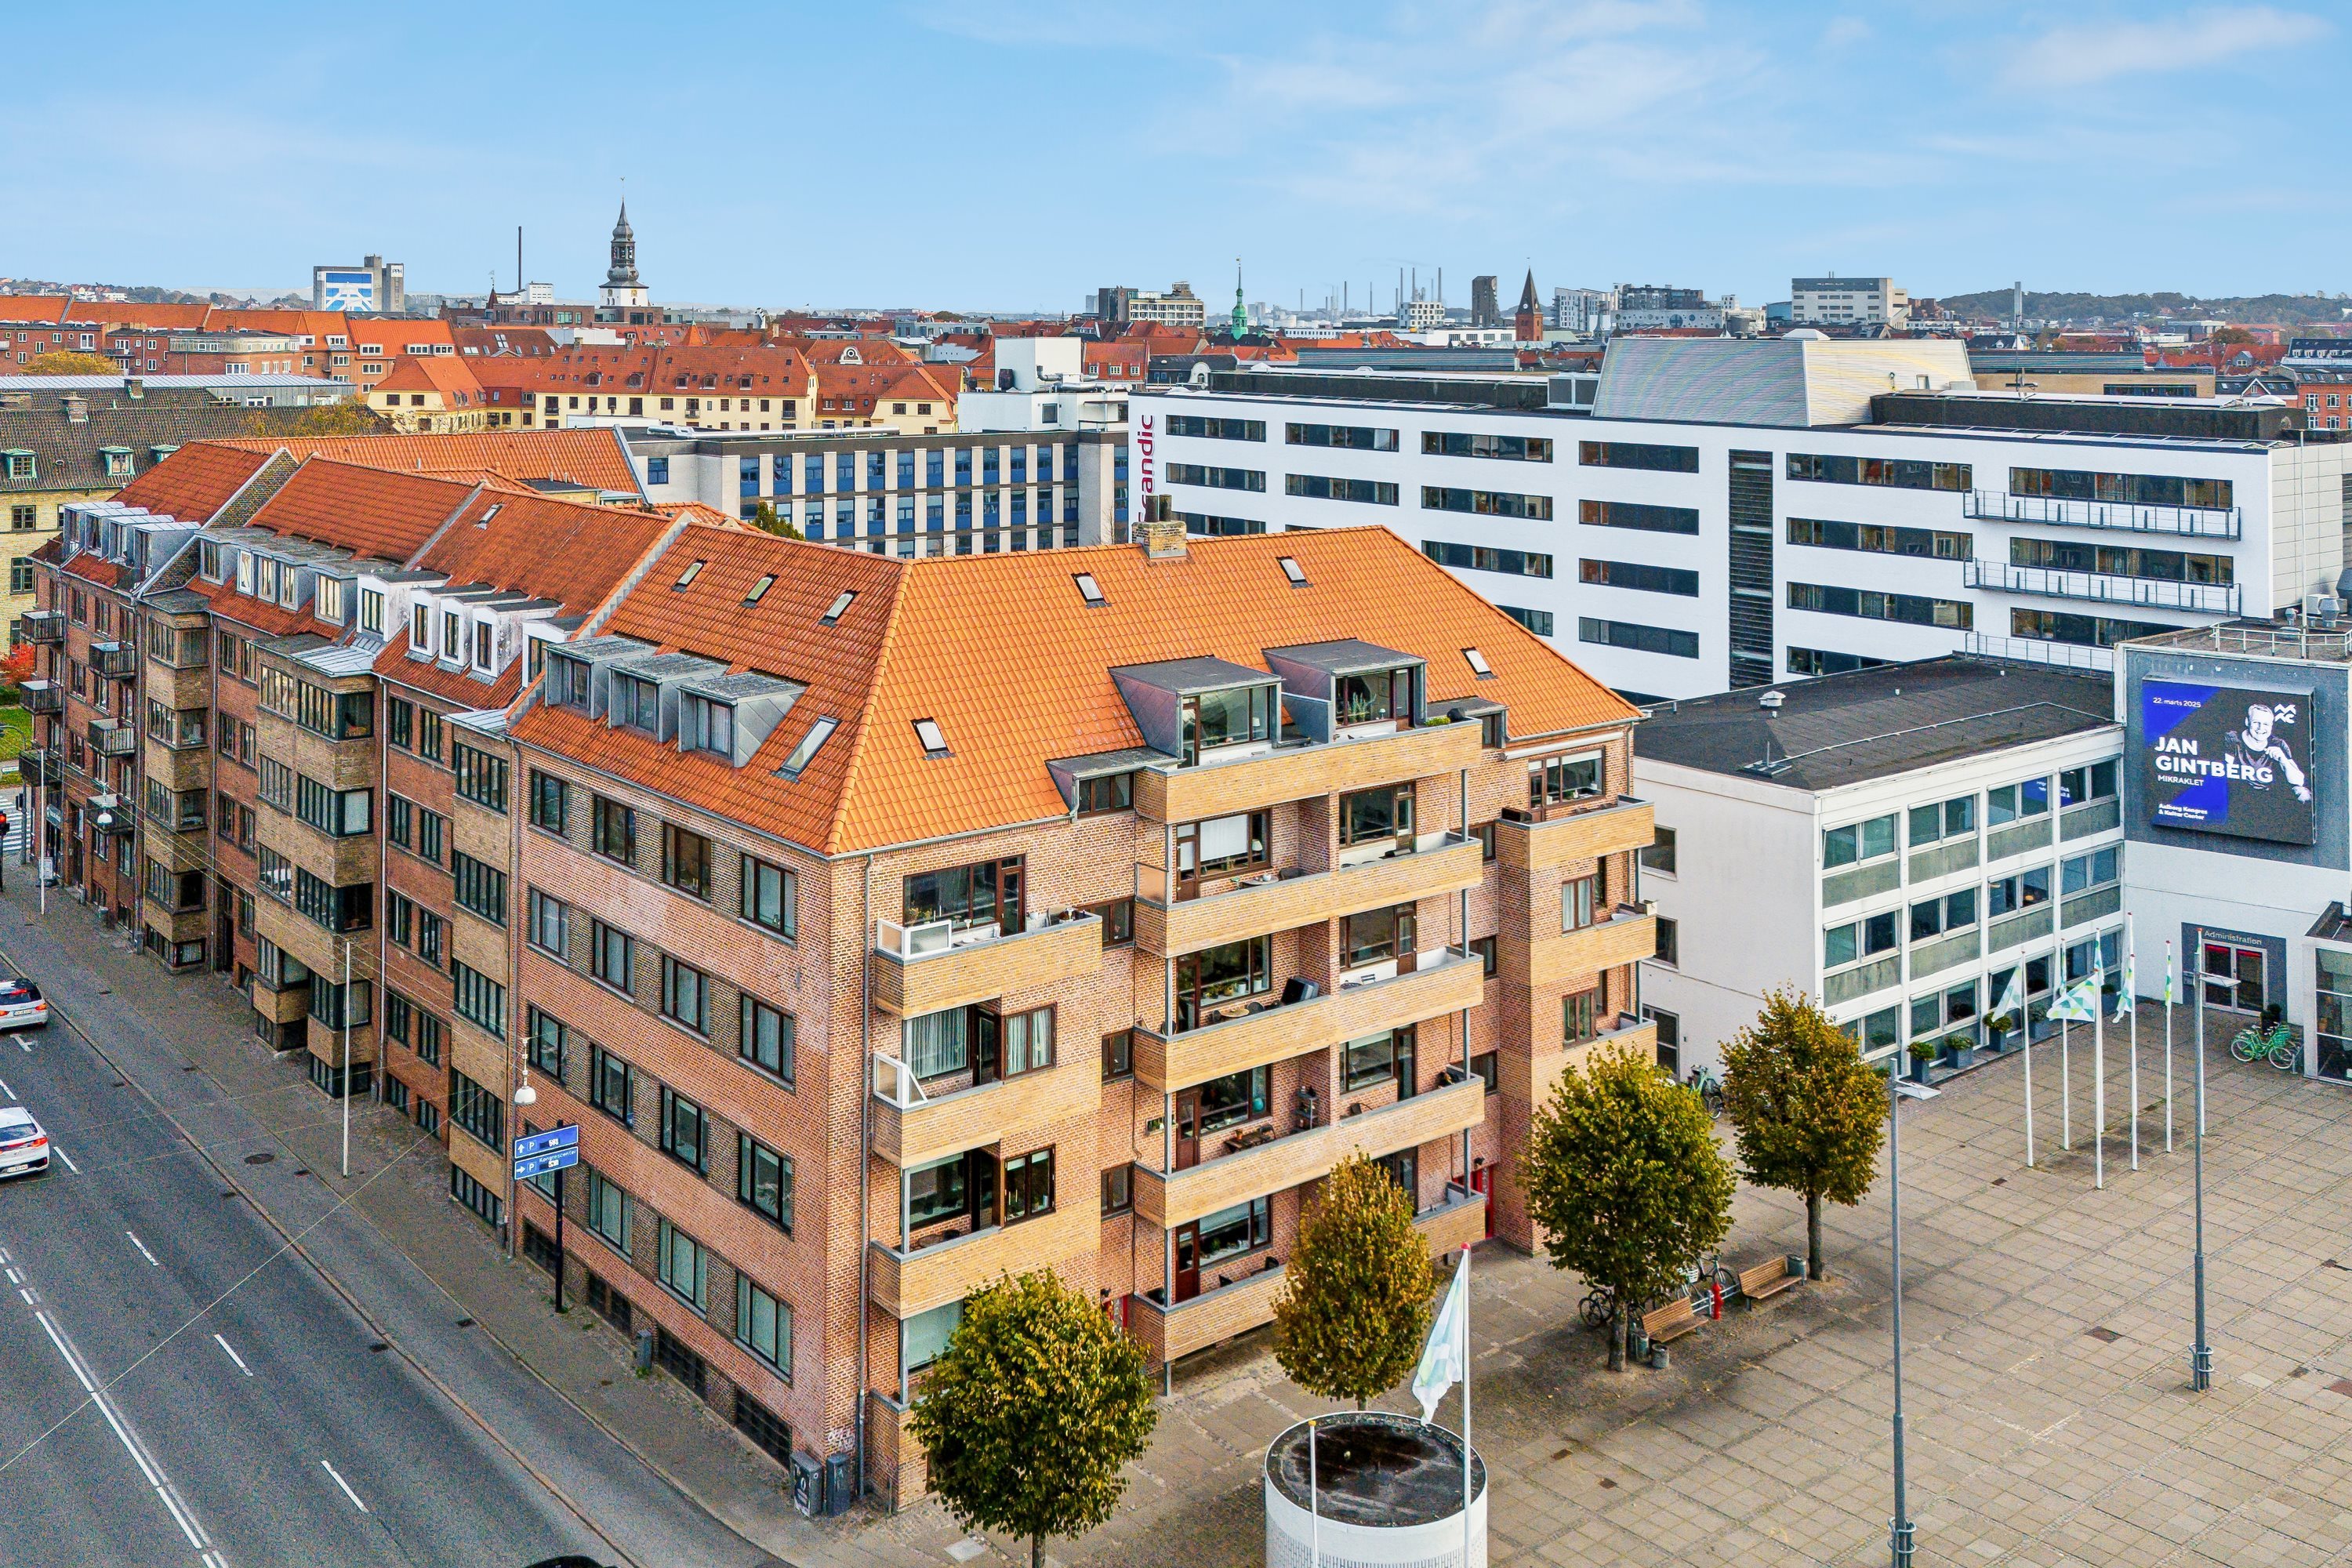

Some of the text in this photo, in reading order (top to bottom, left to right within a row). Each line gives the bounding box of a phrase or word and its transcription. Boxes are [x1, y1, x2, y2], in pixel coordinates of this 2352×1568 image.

[2154, 736, 2198, 756] JAN
[2155, 755, 2274, 783] GINTBERG
[2157, 774, 2205, 786] MIKRAKLET
[2204, 930, 2262, 946] Administration
[529, 1142, 535, 1150] P
[539, 1149, 576, 1163] Kongrescenter
